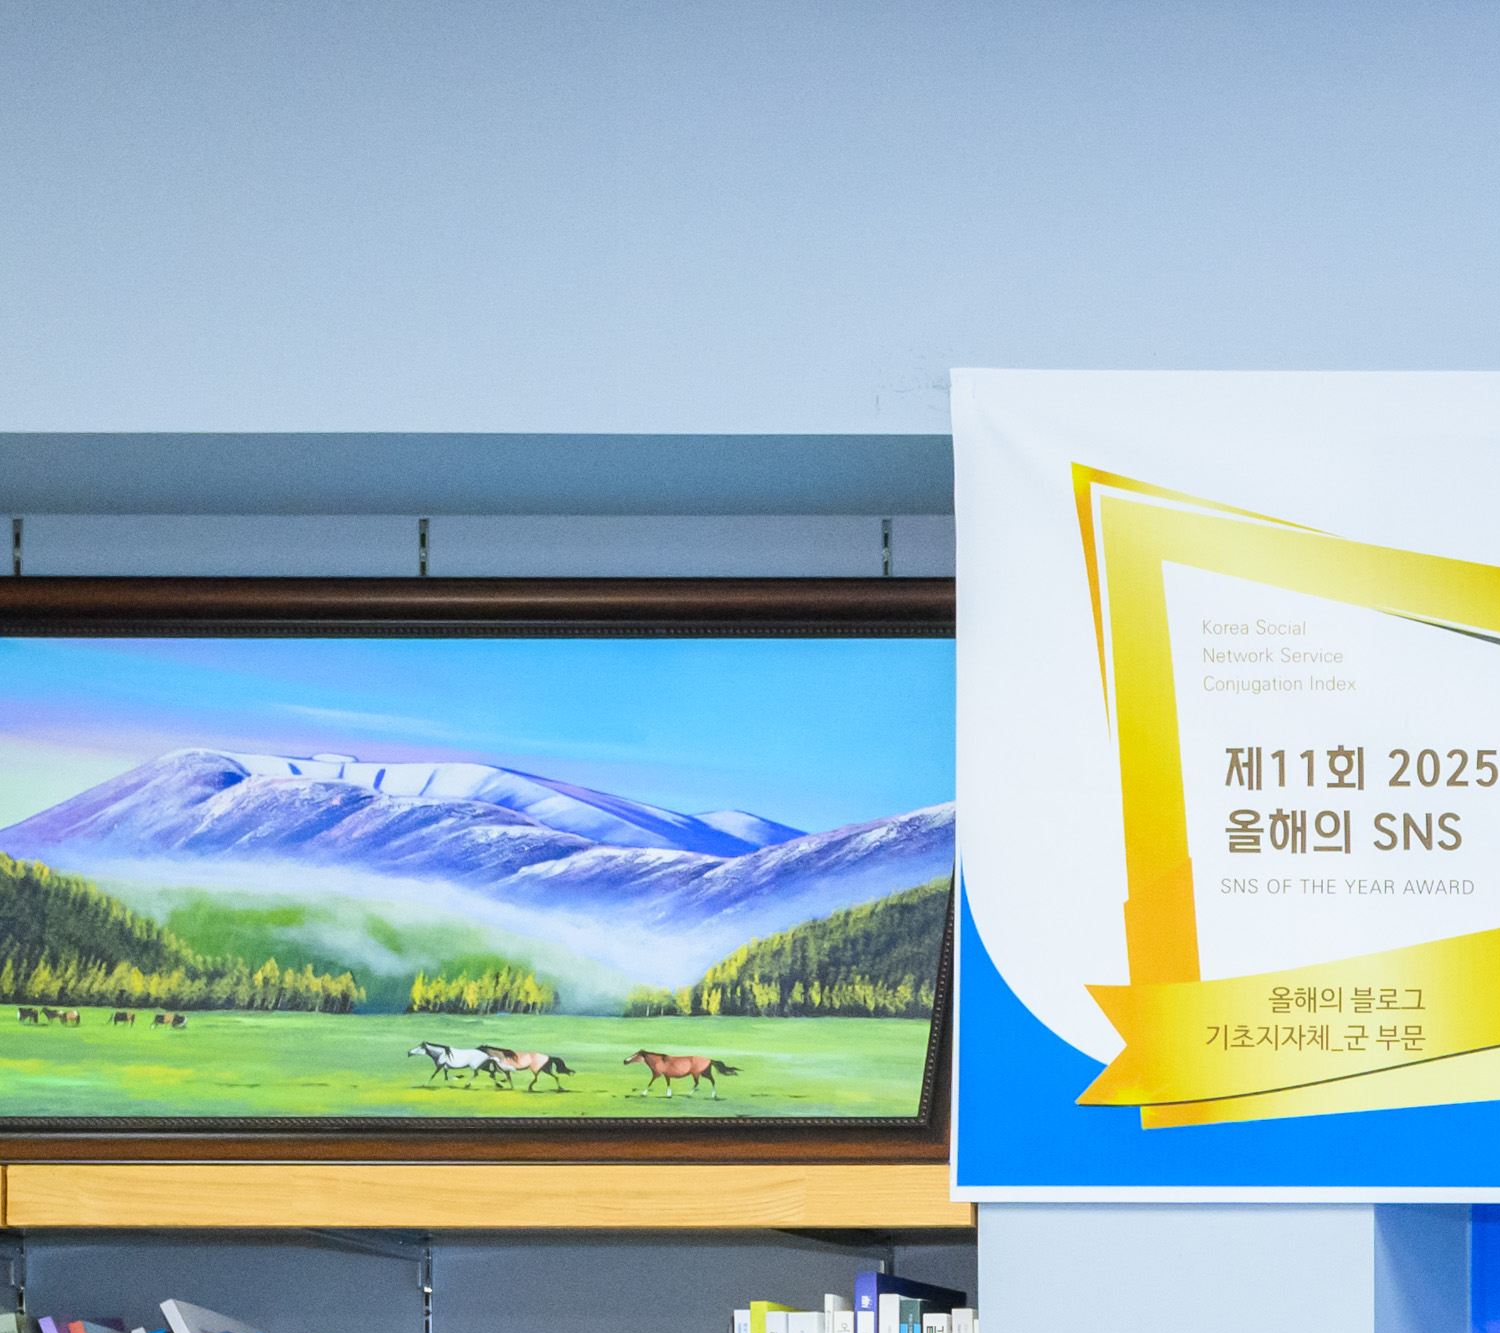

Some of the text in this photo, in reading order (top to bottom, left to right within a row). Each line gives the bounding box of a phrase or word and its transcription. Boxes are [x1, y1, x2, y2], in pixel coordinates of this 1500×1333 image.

[1202, 618, 1306, 635] Korea Social
[1203, 647, 1343, 664] Network Service
[1203, 675, 1357, 695] Conjugation Index
[1224, 745, 1500, 791] 제11회 2025
[1224, 809, 1463, 855] 올해의 SNS
[1220, 878, 1475, 895] SNS OF THE YEAR AWARD
[1268, 985, 1426, 1014] 올해의 블로그
[1205, 1023, 1427, 1055] 기초지자체_군 부문
